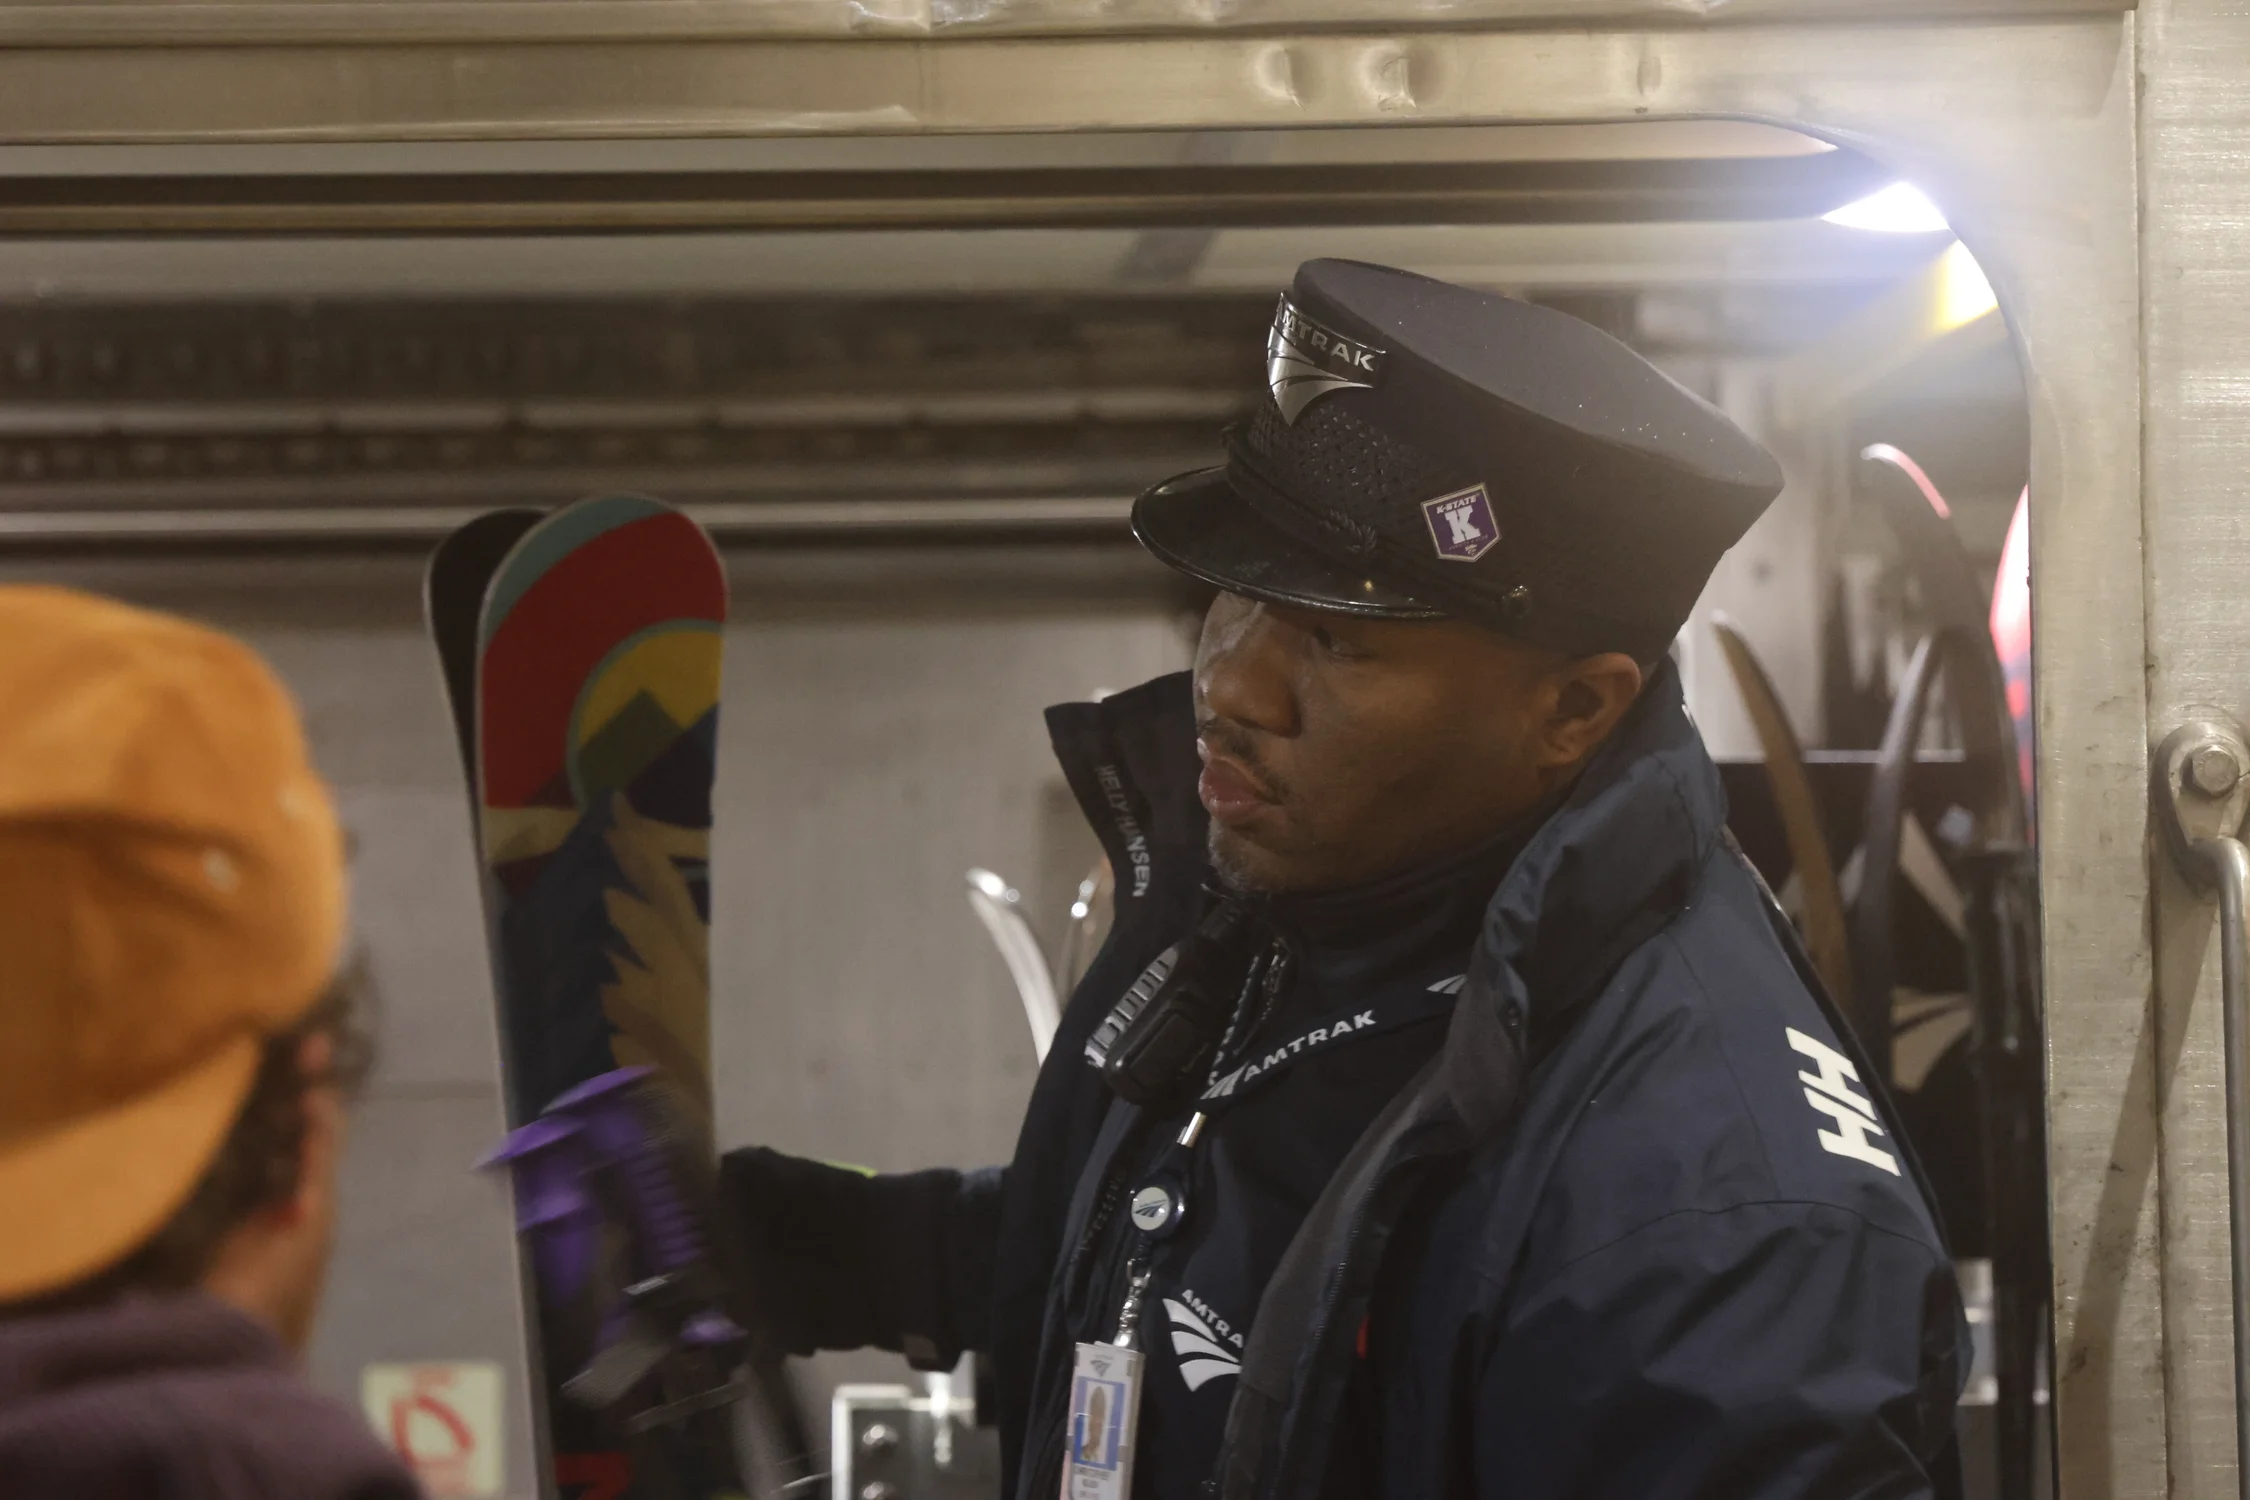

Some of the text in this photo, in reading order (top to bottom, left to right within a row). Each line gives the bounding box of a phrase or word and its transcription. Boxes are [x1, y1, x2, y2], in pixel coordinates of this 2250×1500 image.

[1275, 298, 1376, 372] AMTRAK
[1436, 494, 1477, 515] K-STATE
[1444, 505, 1481, 545] K
[1115, 815, 1150, 897] HANSEN
[1244, 1009, 1377, 1082] AMTRAK
[1785, 1027, 1902, 1177] HH
